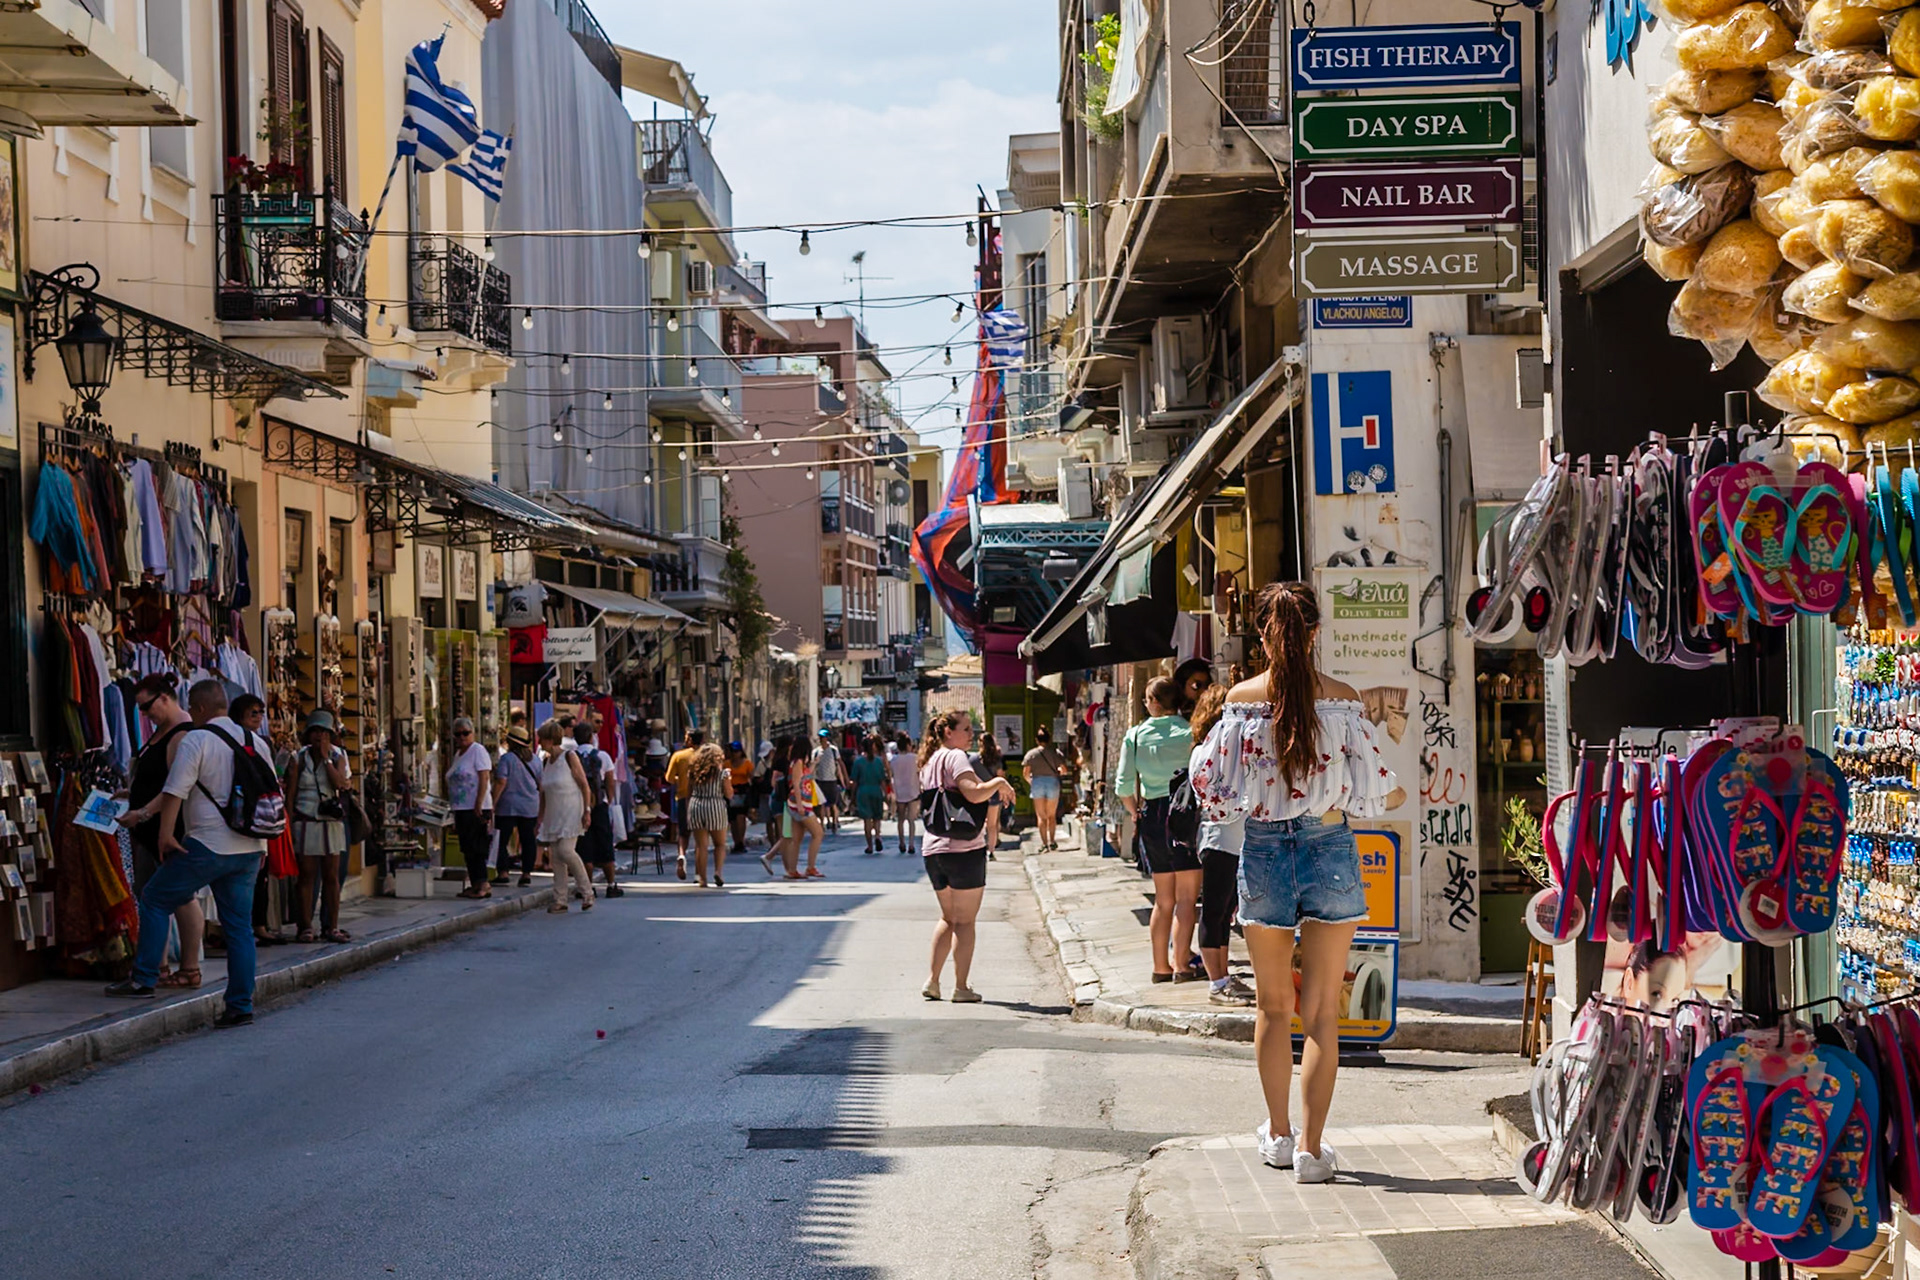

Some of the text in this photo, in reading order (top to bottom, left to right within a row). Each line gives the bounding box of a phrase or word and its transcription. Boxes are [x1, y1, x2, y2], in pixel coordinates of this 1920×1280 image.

[1309, 43, 1505, 69] FISH THERAPY
[1346, 114, 1468, 138] DAY SPA
[1341, 183, 1475, 207] NAIL BAR
[1339, 253, 1479, 277] MASSAGE
[1322, 307, 1404, 319] VLACHOU ANGELOU
[1333, 629, 1407, 642] handmade
[1334, 644, 1407, 657] olivewood
[1361, 851, 1387, 867] sh
